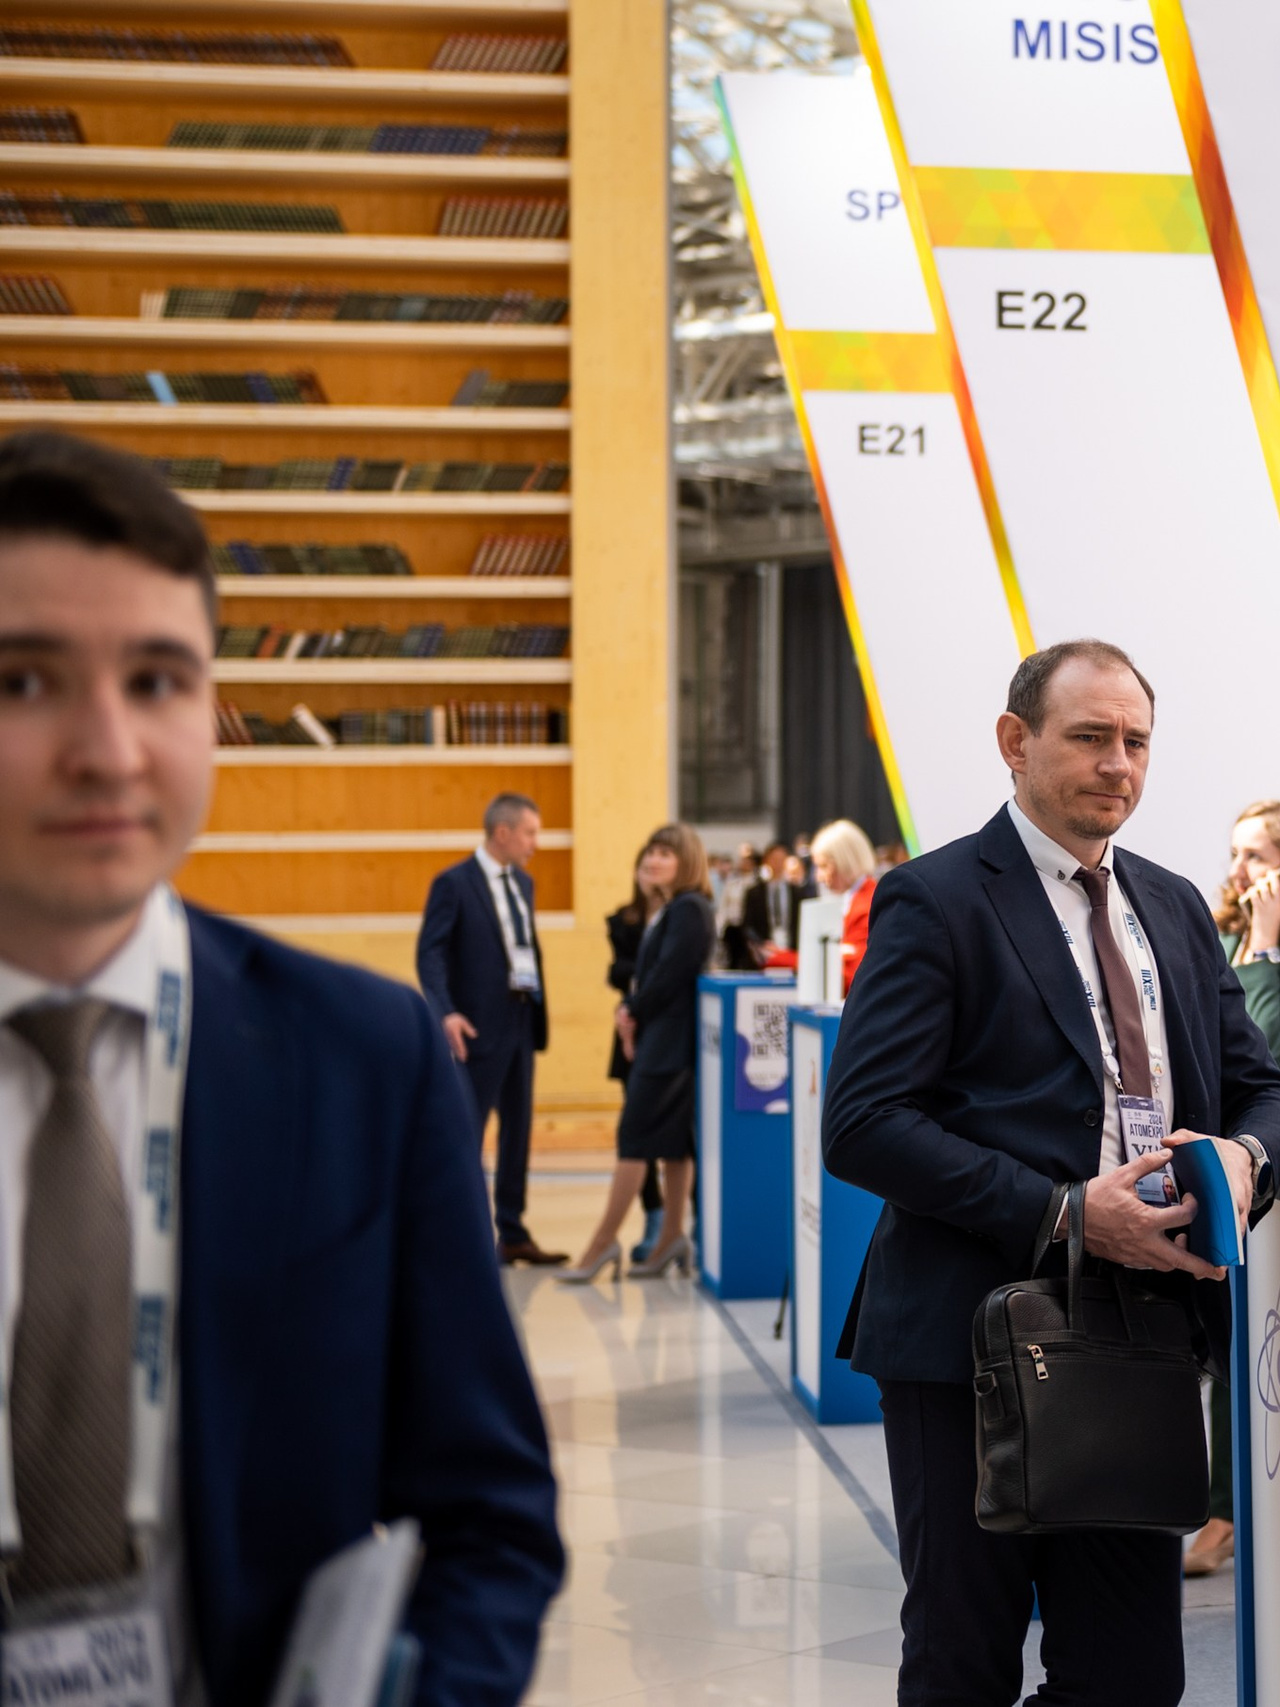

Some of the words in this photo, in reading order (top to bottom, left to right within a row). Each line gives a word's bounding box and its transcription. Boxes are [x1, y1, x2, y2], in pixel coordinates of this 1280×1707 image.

[1013, 18, 1159, 65] MISIS
[846, 188, 901, 221] SP
[996, 290, 1088, 331] E22
[857, 424, 926, 456] E21
[1141, 969, 1154, 986] XIII
[1129, 1123, 1164, 1139] ATOMEXPO
[1148, 1113, 1163, 1125] 2024
